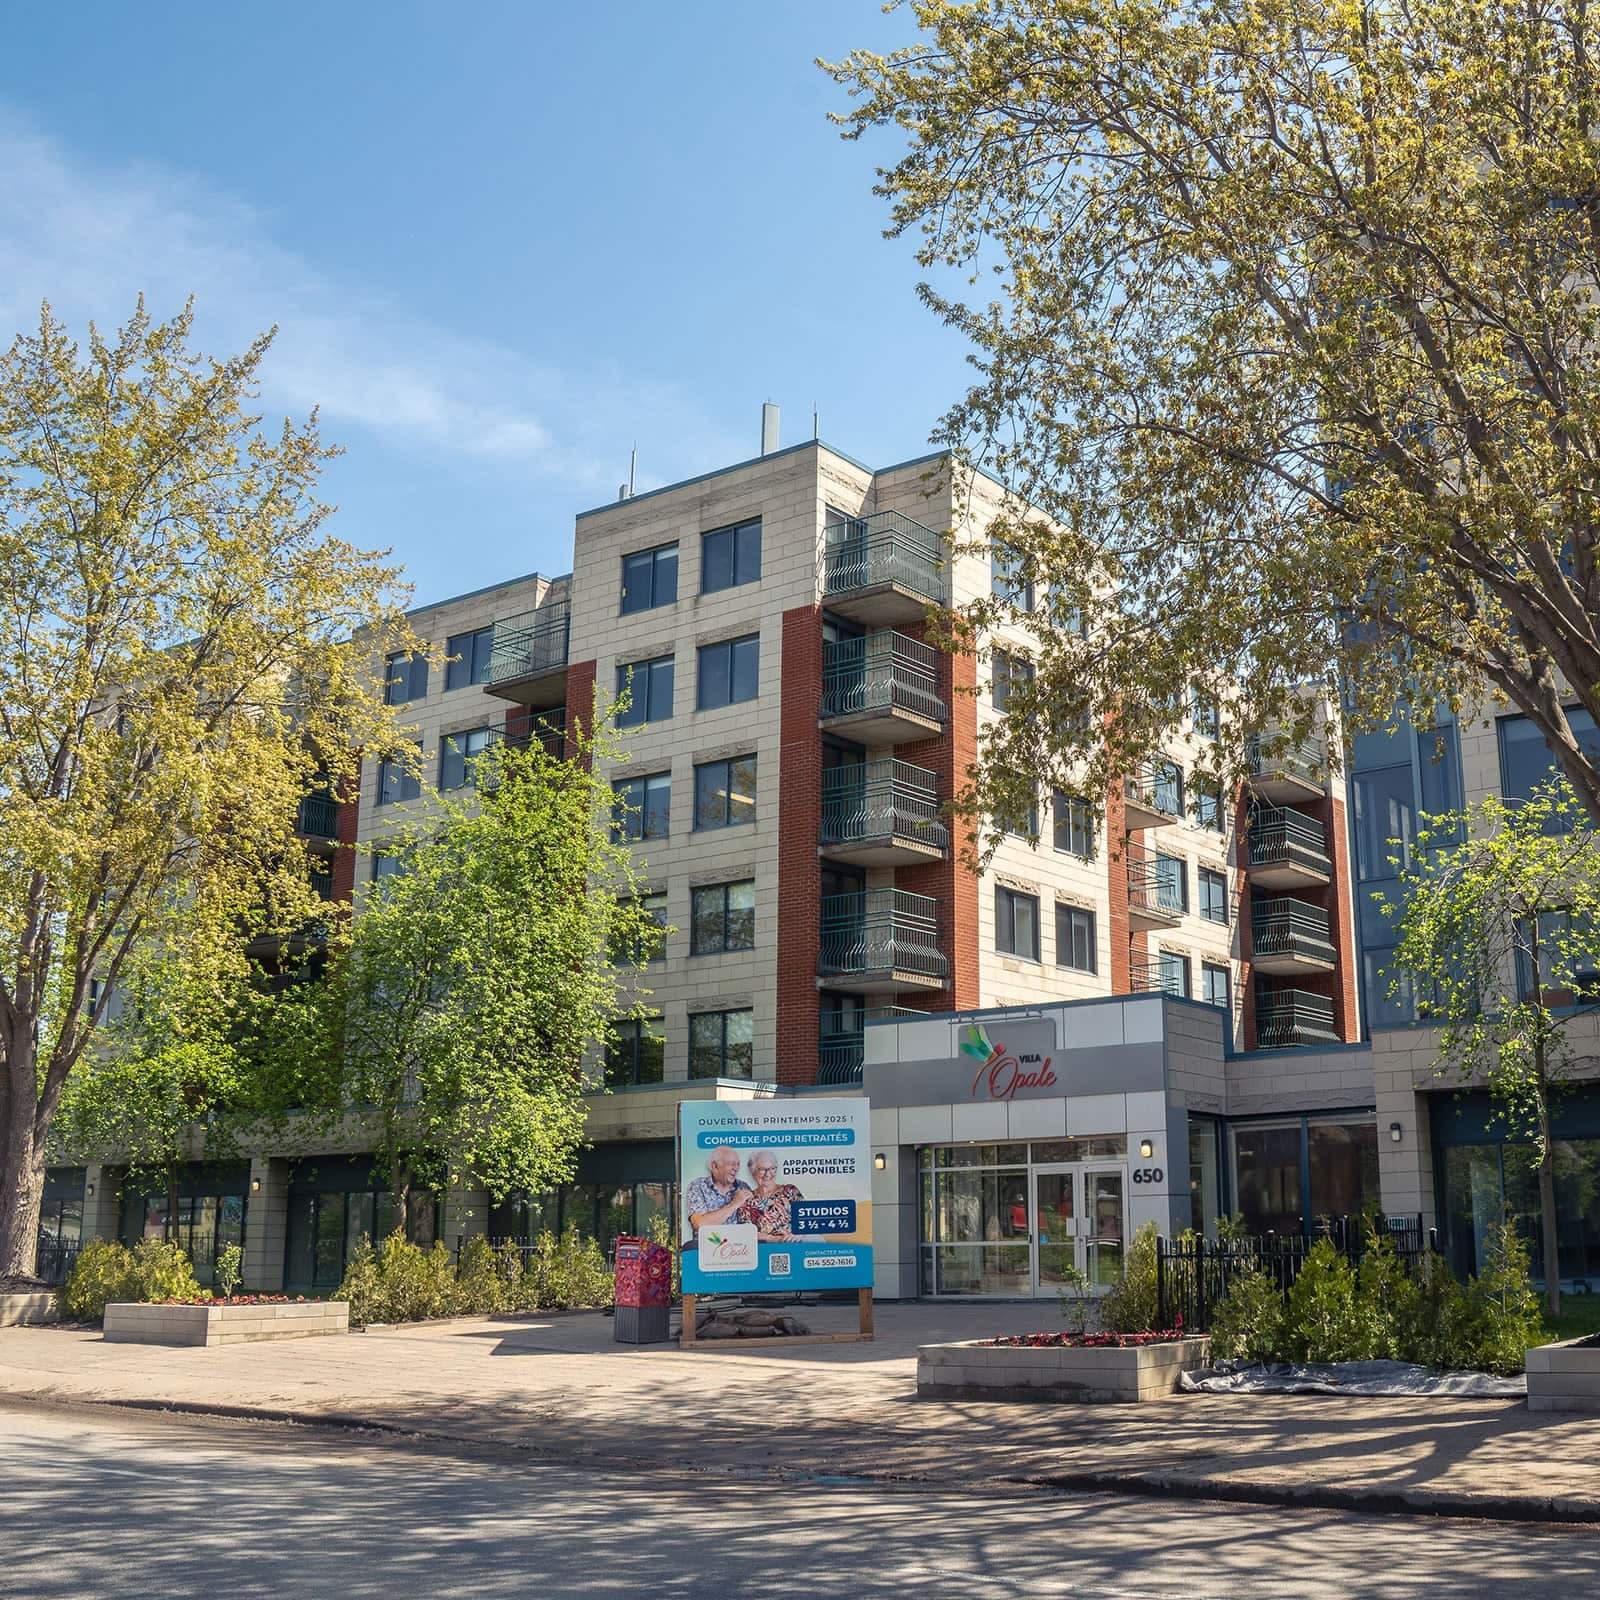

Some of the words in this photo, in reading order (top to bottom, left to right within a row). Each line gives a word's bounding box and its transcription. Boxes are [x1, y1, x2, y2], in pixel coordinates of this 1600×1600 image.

[1019, 1054, 1041, 1064] VILLA
[989, 1056, 1057, 1098] Opale
[698, 1117, 760, 1126] OUVERTURE
[763, 1116, 821, 1125] PRINTEMPS
[824, 1115, 847, 1124] 2025
[704, 1135, 760, 1145] COMPLEXE
[762, 1134, 792, 1144] POUR
[794, 1131, 849, 1143] RETRAITÉS
[783, 1158, 856, 1166] APPARTEMENTS
[783, 1165, 856, 1175] DISPONIBLES
[1133, 1168, 1164, 1184] 650
[798, 1206, 849, 1217] STUDIOS
[798, 1220, 806, 1230] 3
[828, 1219, 836, 1229] 4
[807, 1259, 820, 1267] 514
